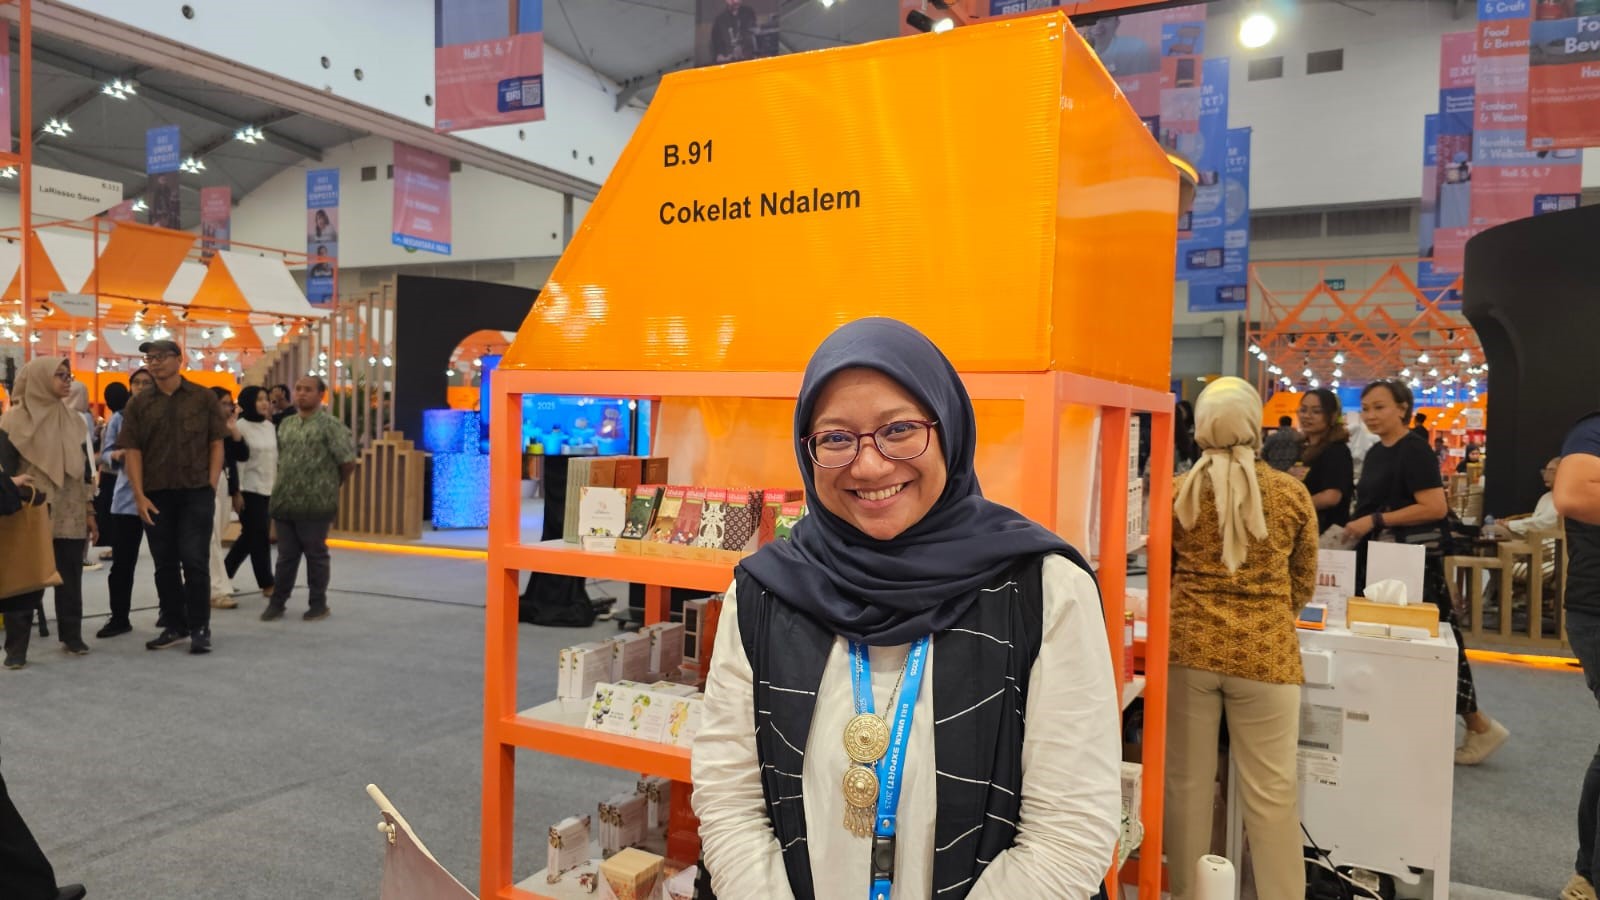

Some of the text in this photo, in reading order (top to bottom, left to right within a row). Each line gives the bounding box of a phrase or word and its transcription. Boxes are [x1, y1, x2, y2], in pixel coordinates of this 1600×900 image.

[1485, 1, 1526, 13] & Craft
[1483, 25, 1510, 37] Food
[1483, 40, 1492, 49] &
[463, 45, 480, 59] Hall
[1481, 102, 1518, 112] Fashion
[663, 139, 713, 167] B.91
[1501, 168, 1518, 177] Hall
[659, 187, 860, 225] Cokelat Ndalem
[901, 703, 909, 717] BRI
[895, 719, 906, 745] UMKM
[884, 790, 894, 809] 2025
